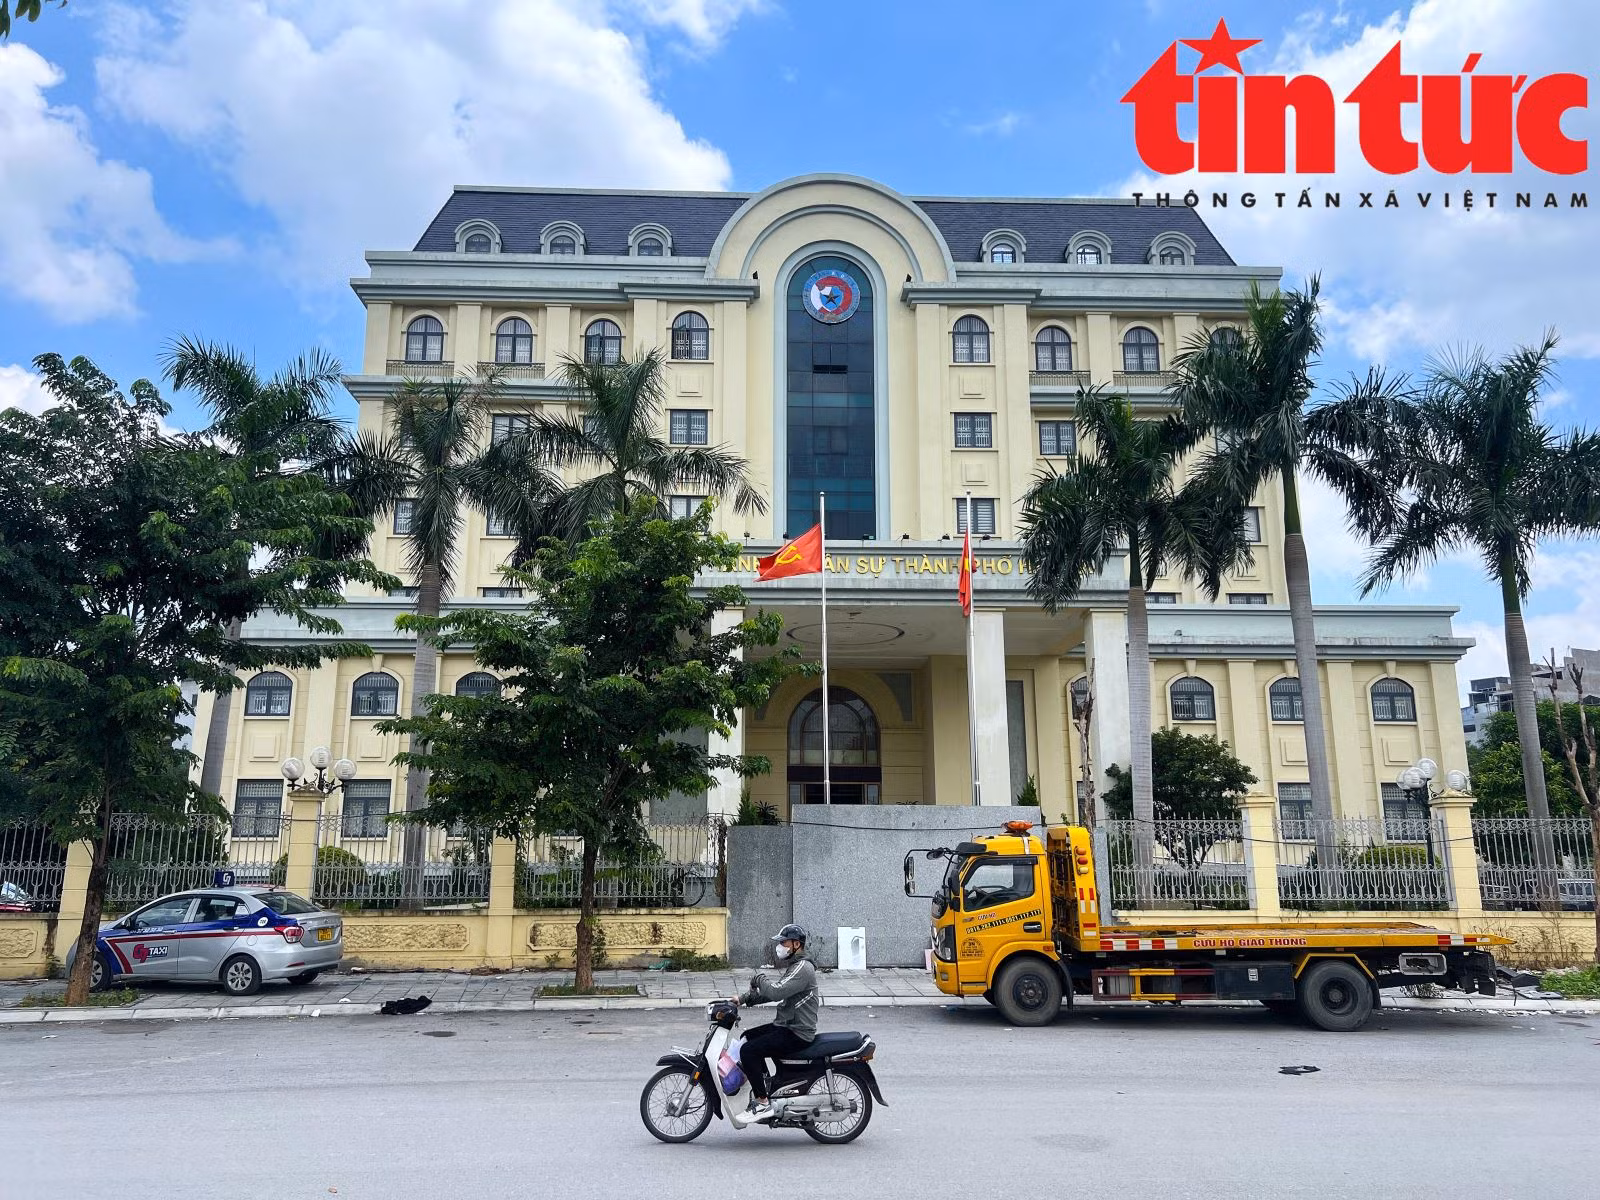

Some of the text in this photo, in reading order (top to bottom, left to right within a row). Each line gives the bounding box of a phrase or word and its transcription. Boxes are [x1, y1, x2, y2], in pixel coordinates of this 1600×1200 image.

[856, 555, 886, 578] SỰ
[892, 554, 962, 575] THÀNH
[1238, 938, 1265, 947] GIAO
[149, 946, 168, 955] TAXI
